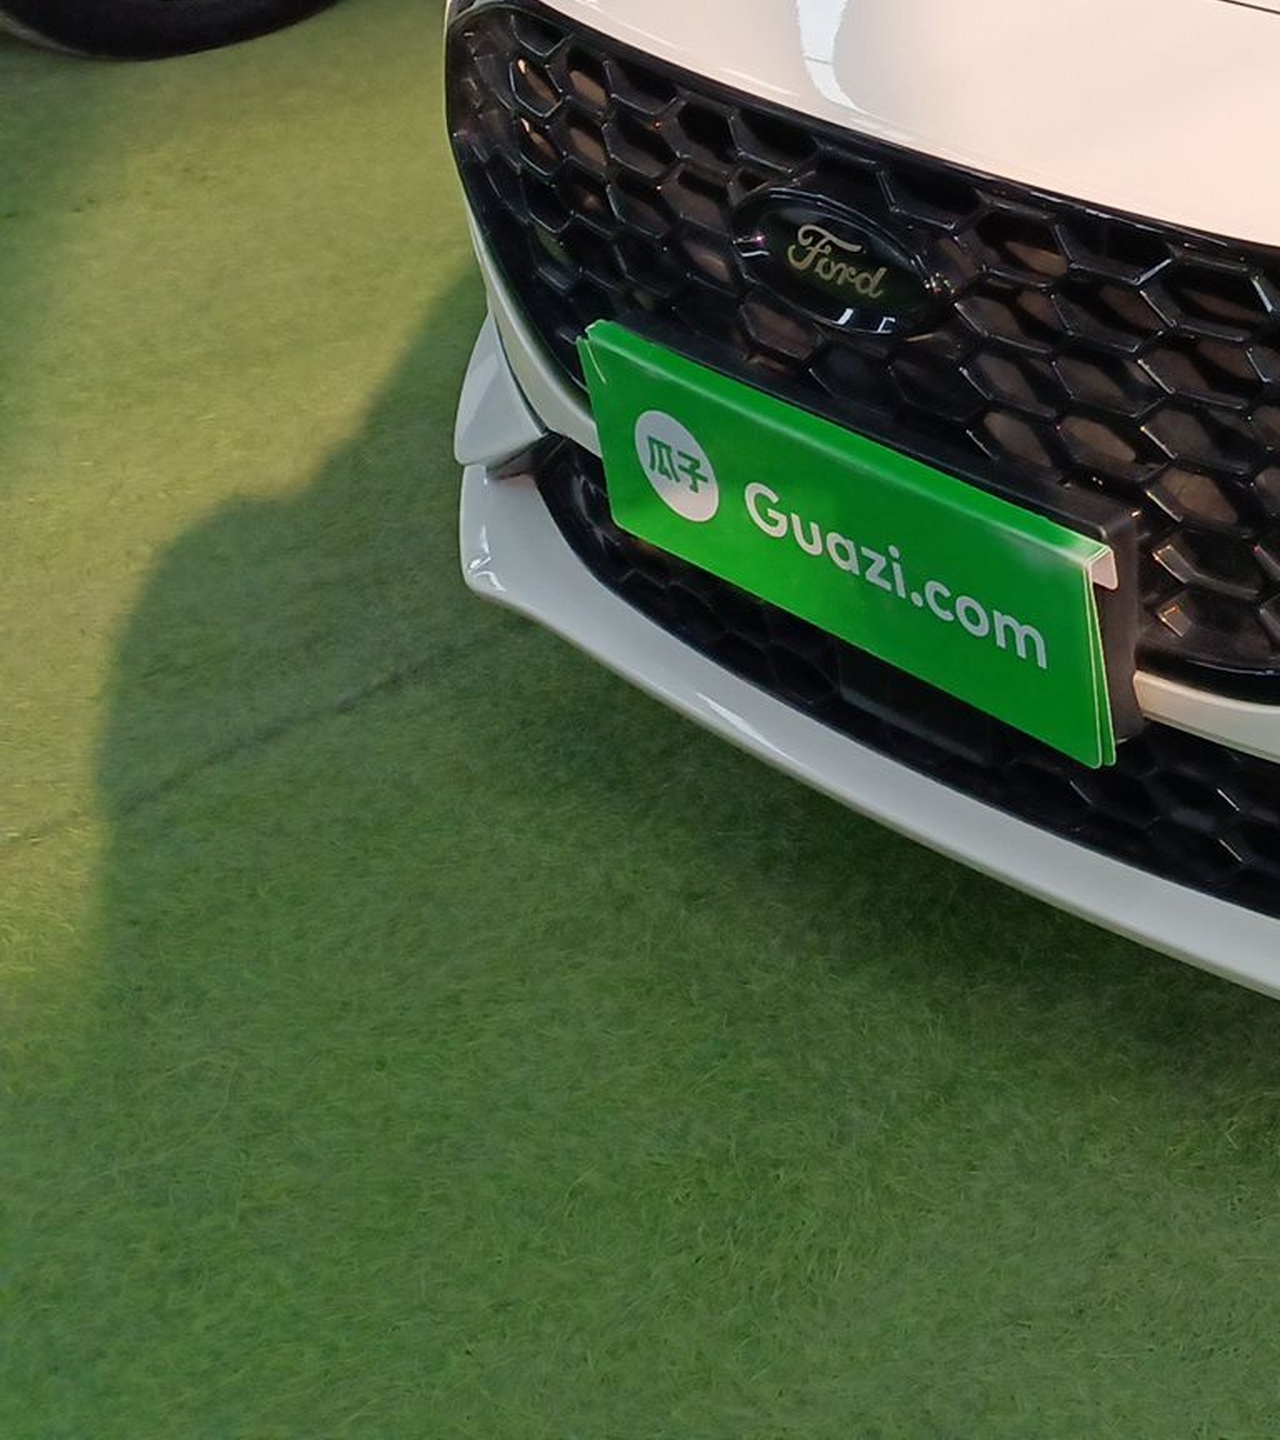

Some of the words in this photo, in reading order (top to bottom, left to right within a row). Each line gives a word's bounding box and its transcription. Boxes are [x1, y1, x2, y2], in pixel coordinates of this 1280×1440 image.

[787, 224, 888, 298] Ford
[647, 435, 708, 494] 瓜子
[744, 482, 1047, 669] Guazi.com
